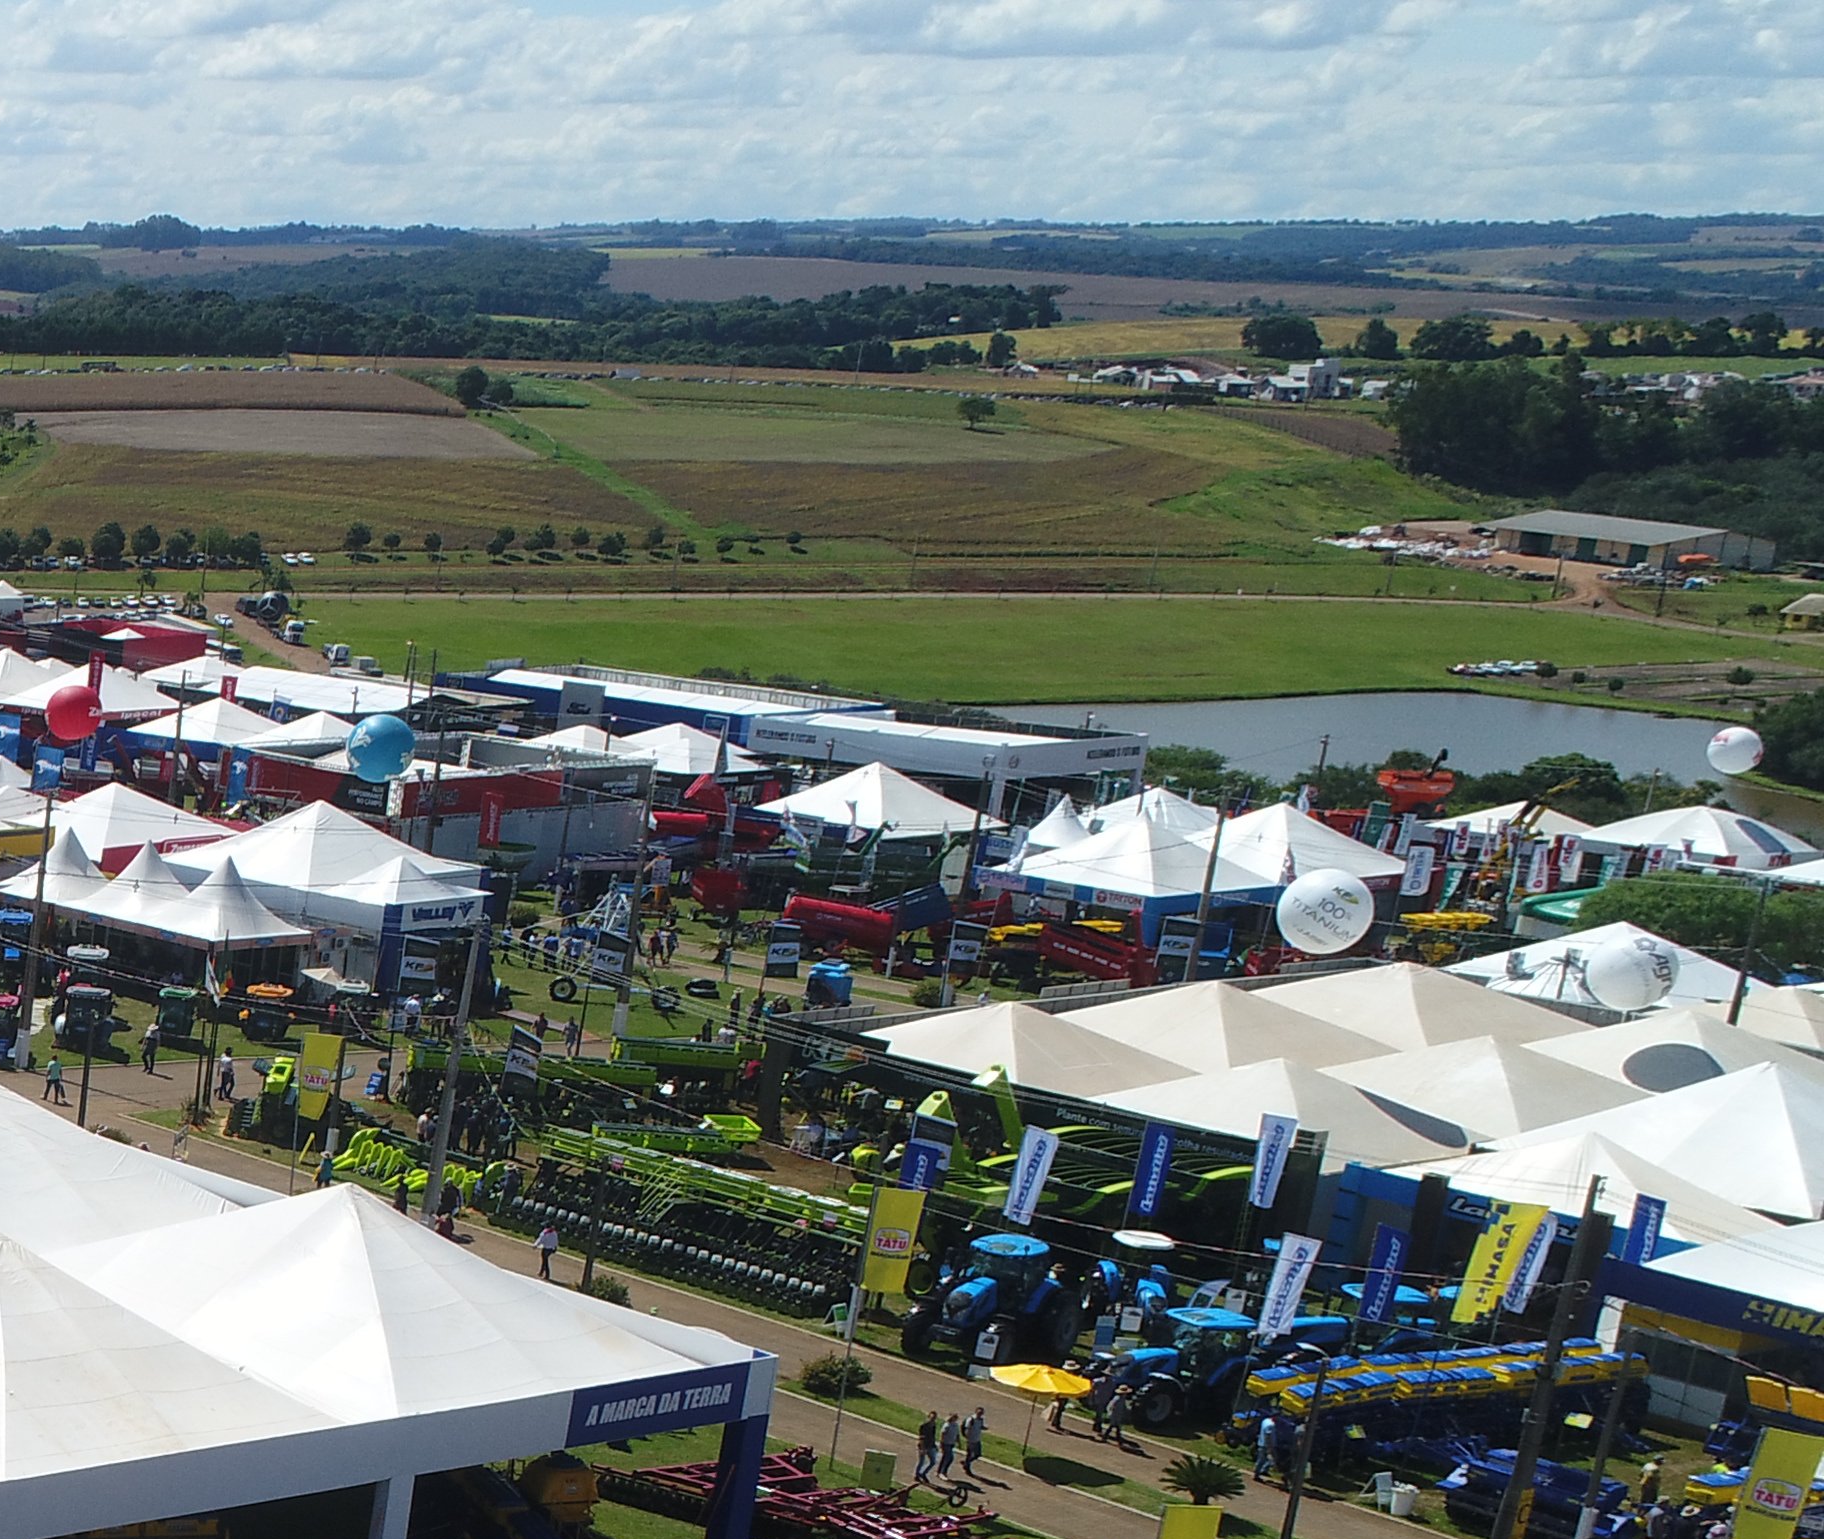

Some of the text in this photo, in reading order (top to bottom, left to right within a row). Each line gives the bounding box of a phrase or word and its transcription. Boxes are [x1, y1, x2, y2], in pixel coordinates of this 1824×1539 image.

[771, 947, 789, 957] KF
[404, 960, 424, 972] KF
[304, 1074, 328, 1087] TATU
[877, 1237, 908, 1250] TATU
[584, 1382, 733, 1428] A MARCA DA TERRA
[1755, 1489, 1798, 1510] TATU
